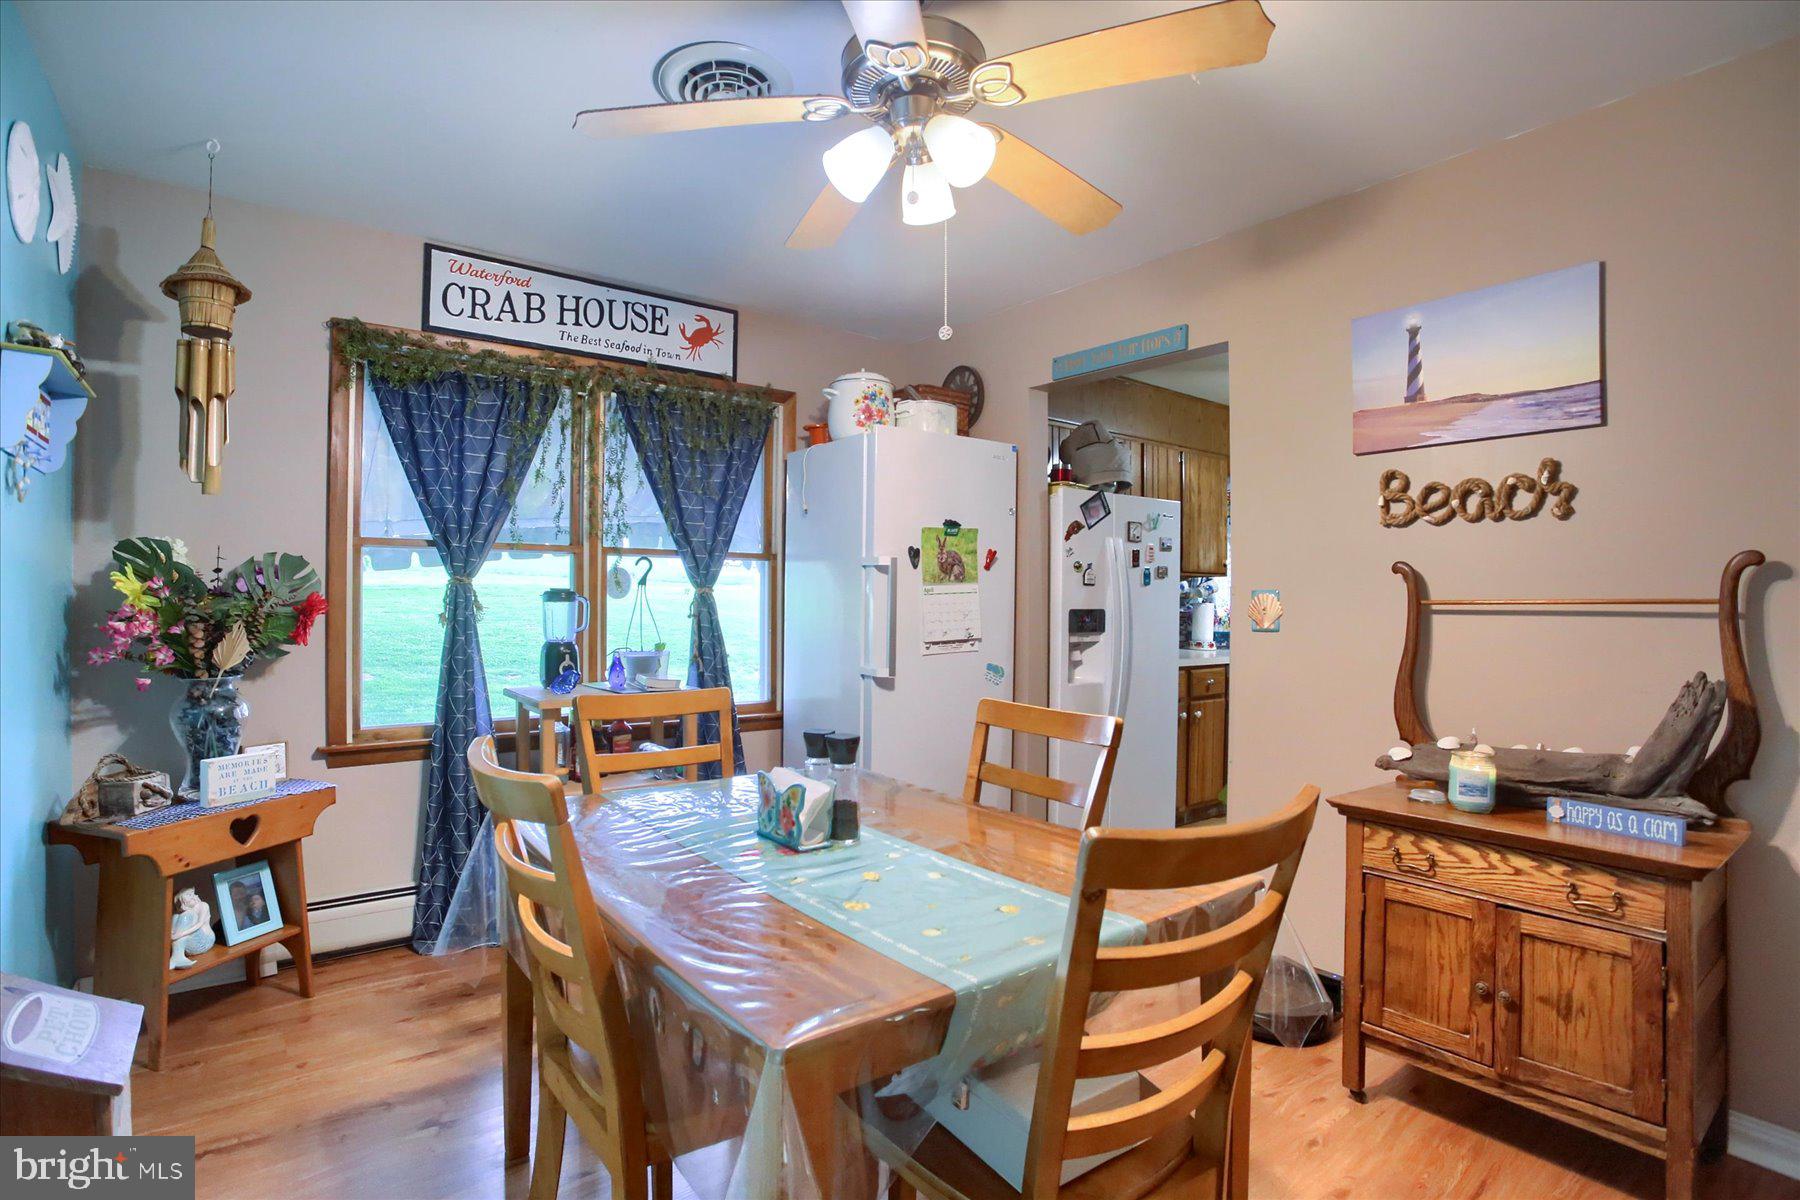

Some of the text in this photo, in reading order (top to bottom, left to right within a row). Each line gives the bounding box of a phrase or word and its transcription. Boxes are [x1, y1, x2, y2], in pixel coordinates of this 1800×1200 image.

[448, 258, 532, 289] Waterford
[441, 282, 669, 336] CRAB HOUSE
[559, 330, 681, 361] The Best Seafood in Town
[1379, 457, 1576, 528] Beach
[218, 759, 268, 771] MEMORIES
[219, 770, 237, 780] ARE
[243, 766, 268, 776] MADE
[218, 779, 268, 797] BEACH
[1566, 802, 1677, 842] happy as a clam
